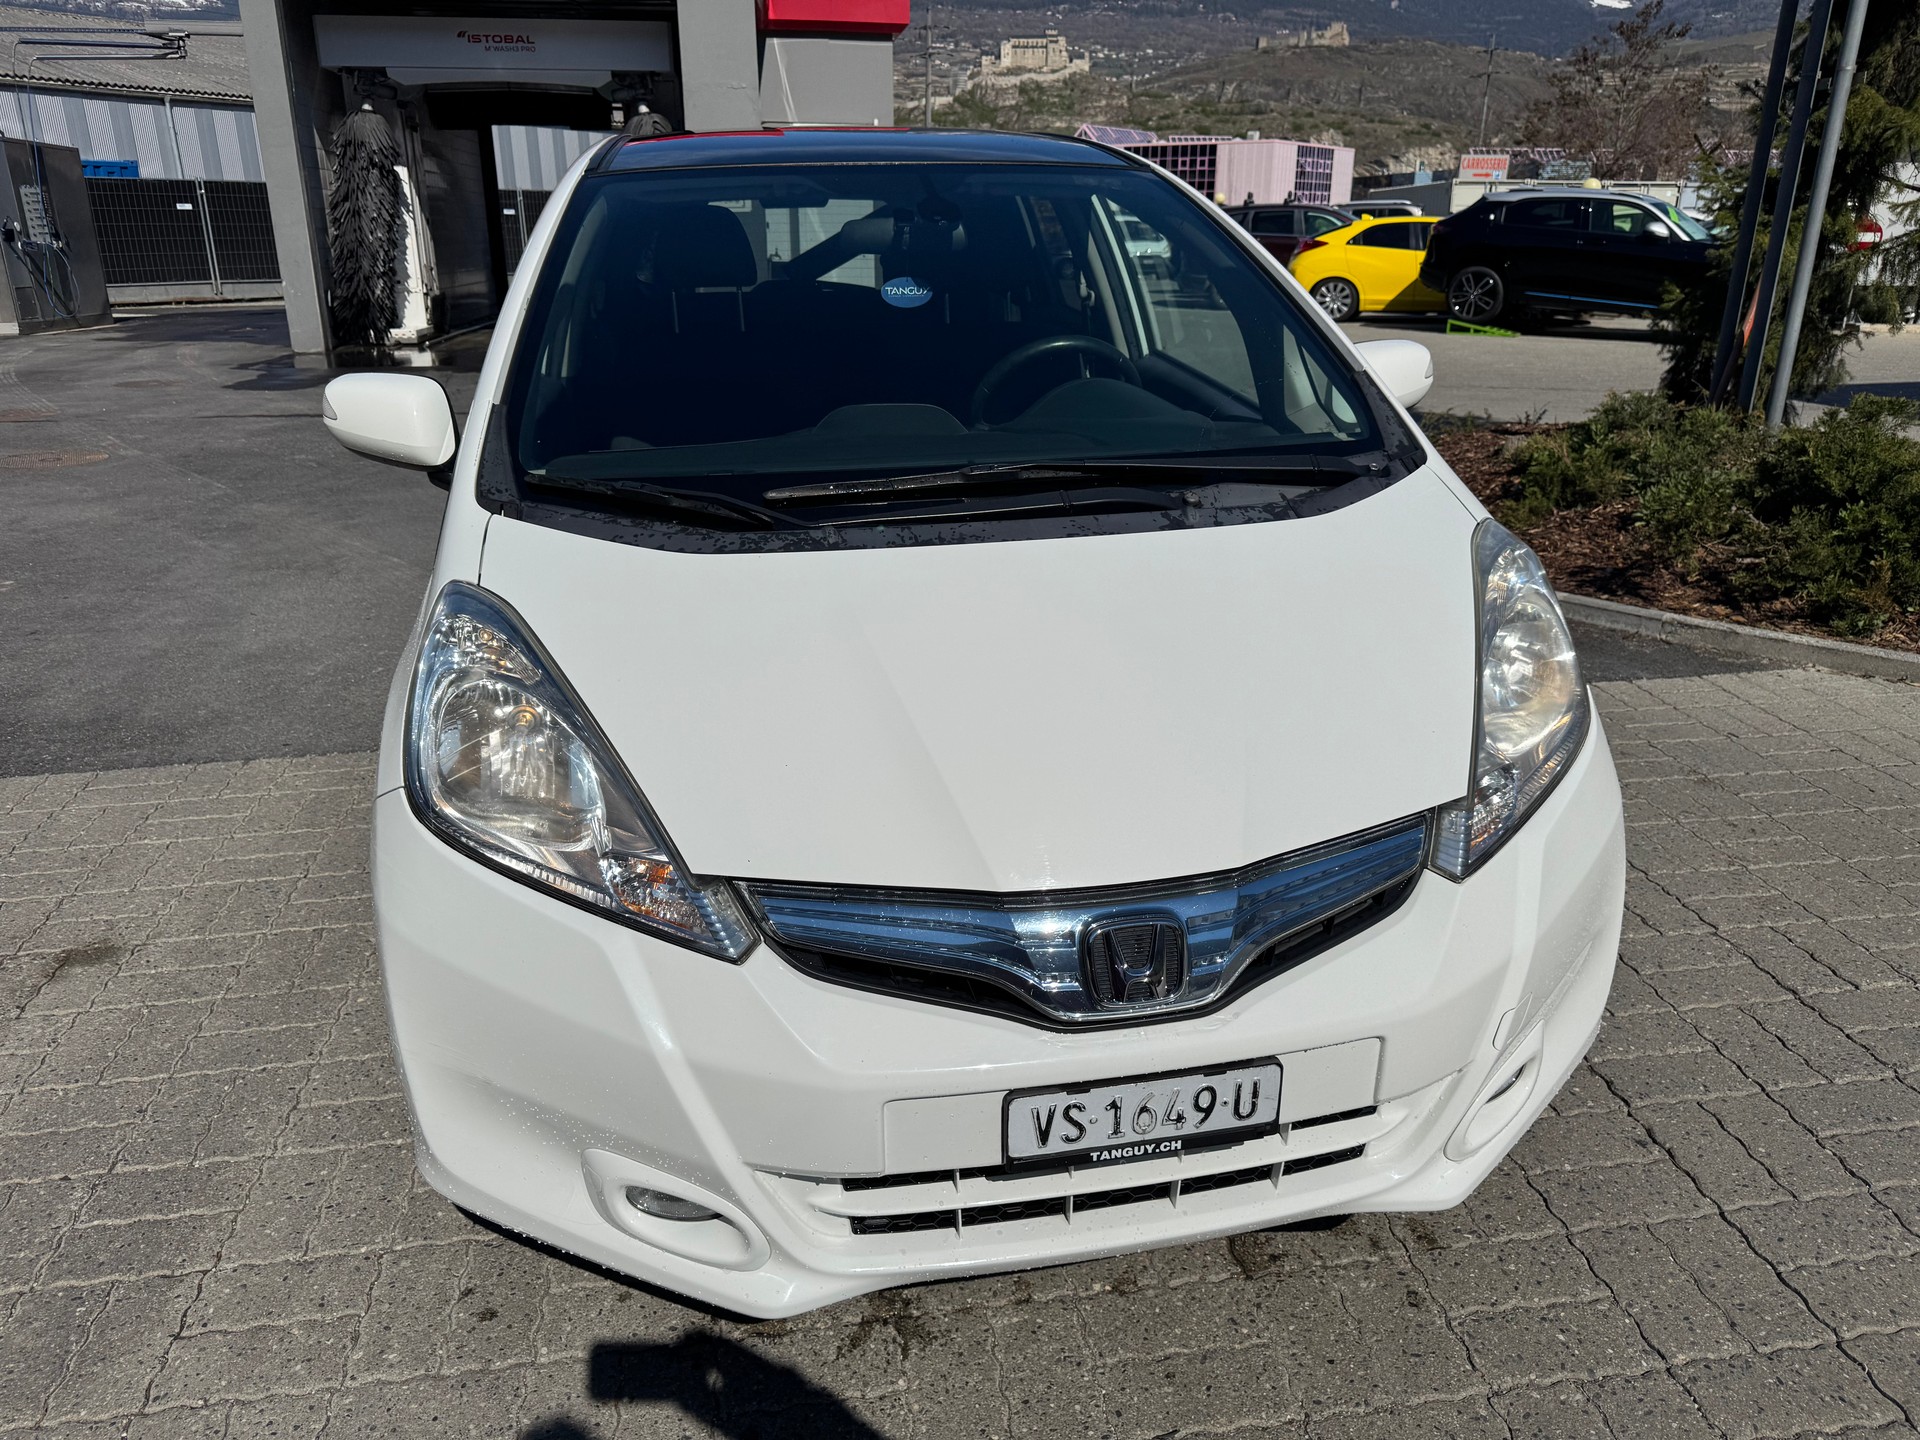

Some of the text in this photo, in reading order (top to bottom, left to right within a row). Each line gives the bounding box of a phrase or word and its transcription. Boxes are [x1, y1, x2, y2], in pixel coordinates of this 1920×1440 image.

[467, 34, 536, 45] ISTOBAL
[520, 45, 536, 53] PRO
[1461, 157, 1508, 170] CARROSSERIE
[885, 286, 930, 295] TANGUY
[1090, 1140, 1183, 1162] TANGUY.CH
